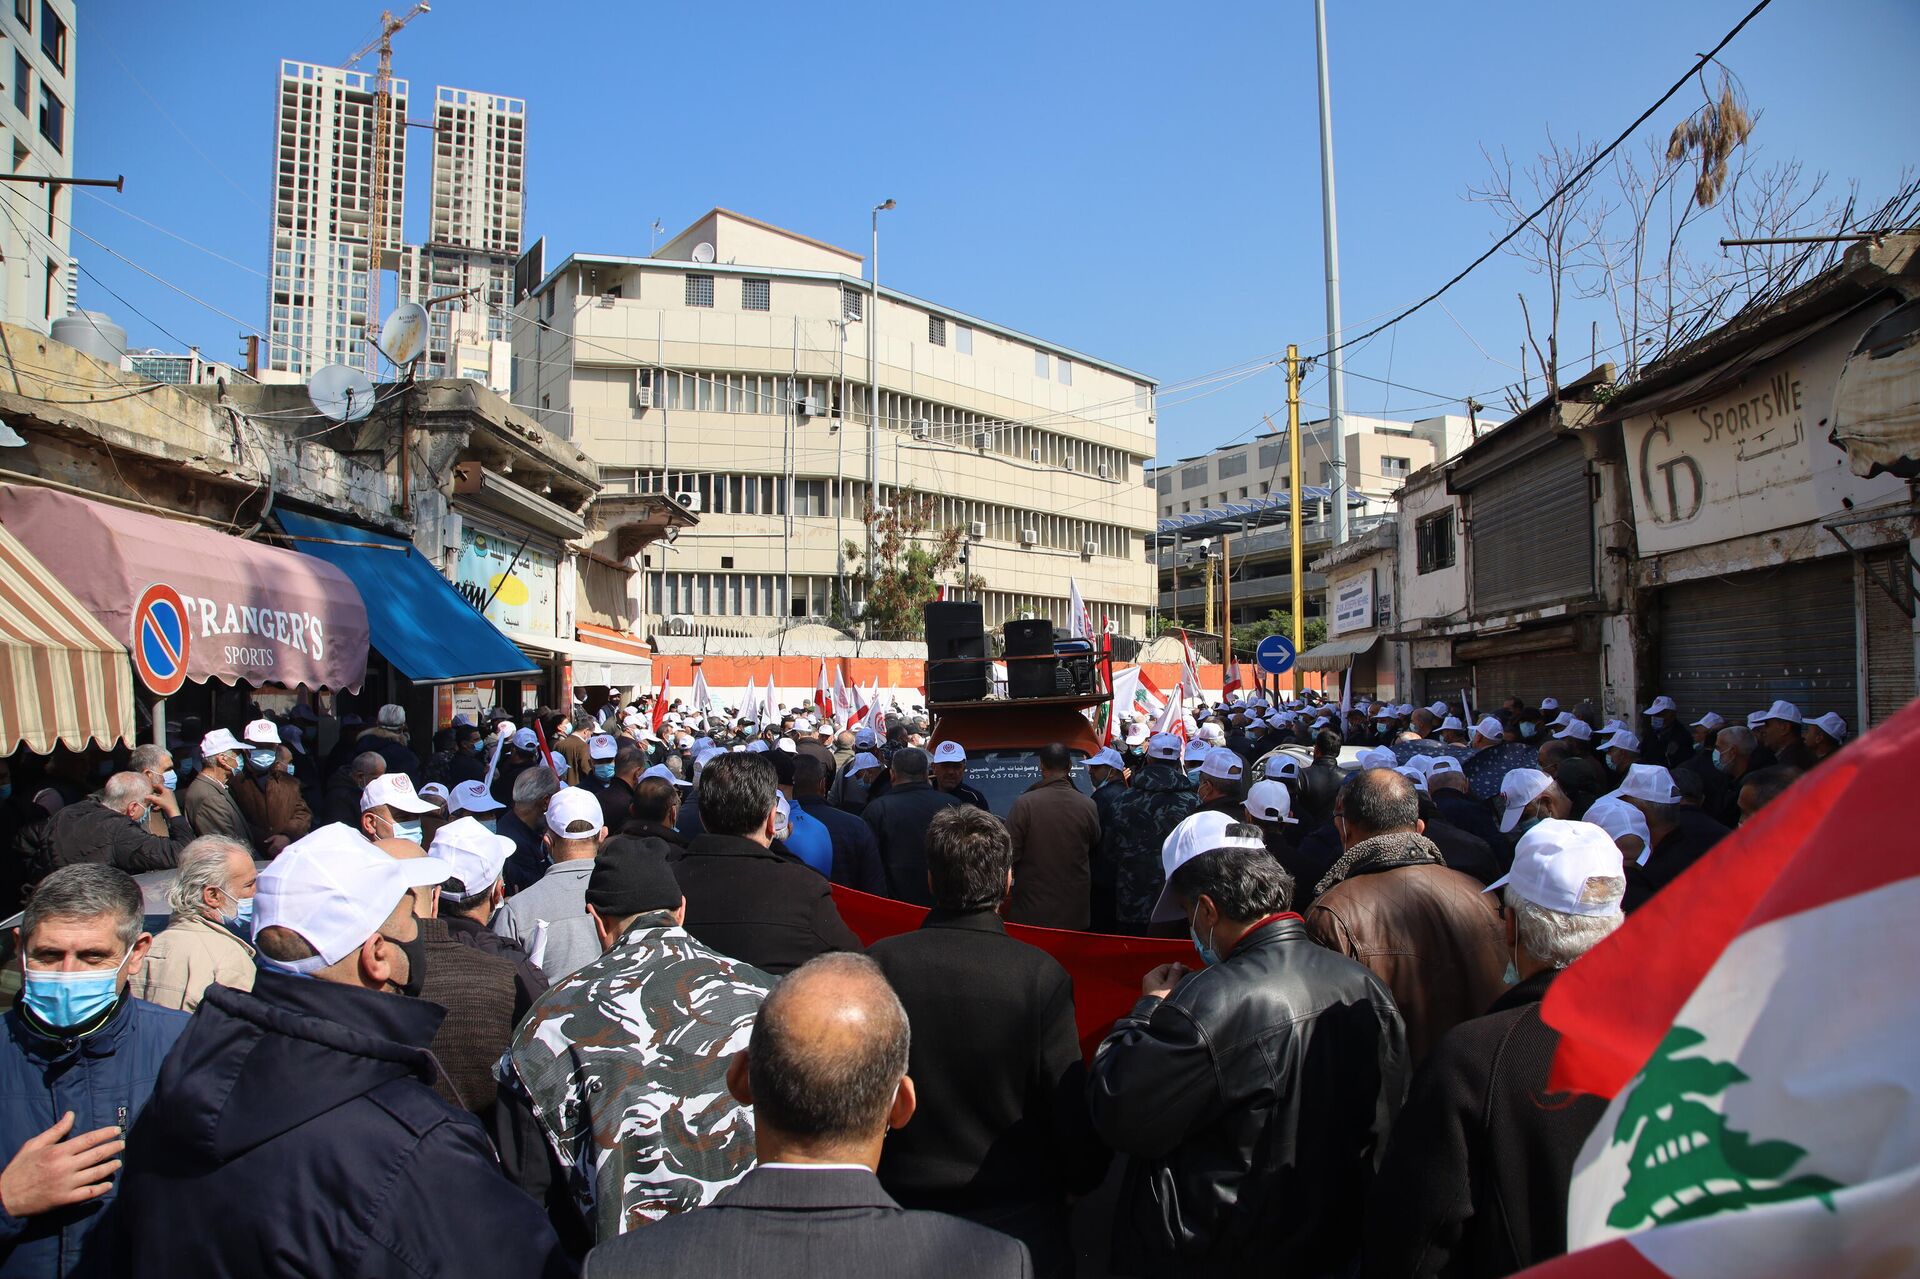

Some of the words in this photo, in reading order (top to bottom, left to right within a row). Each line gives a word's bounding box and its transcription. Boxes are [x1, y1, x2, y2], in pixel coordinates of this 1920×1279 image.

[180, 593, 324, 661] TRANGER'S
[224, 645, 274, 666] SPORTS
[991, 765, 1006, 773] علي
